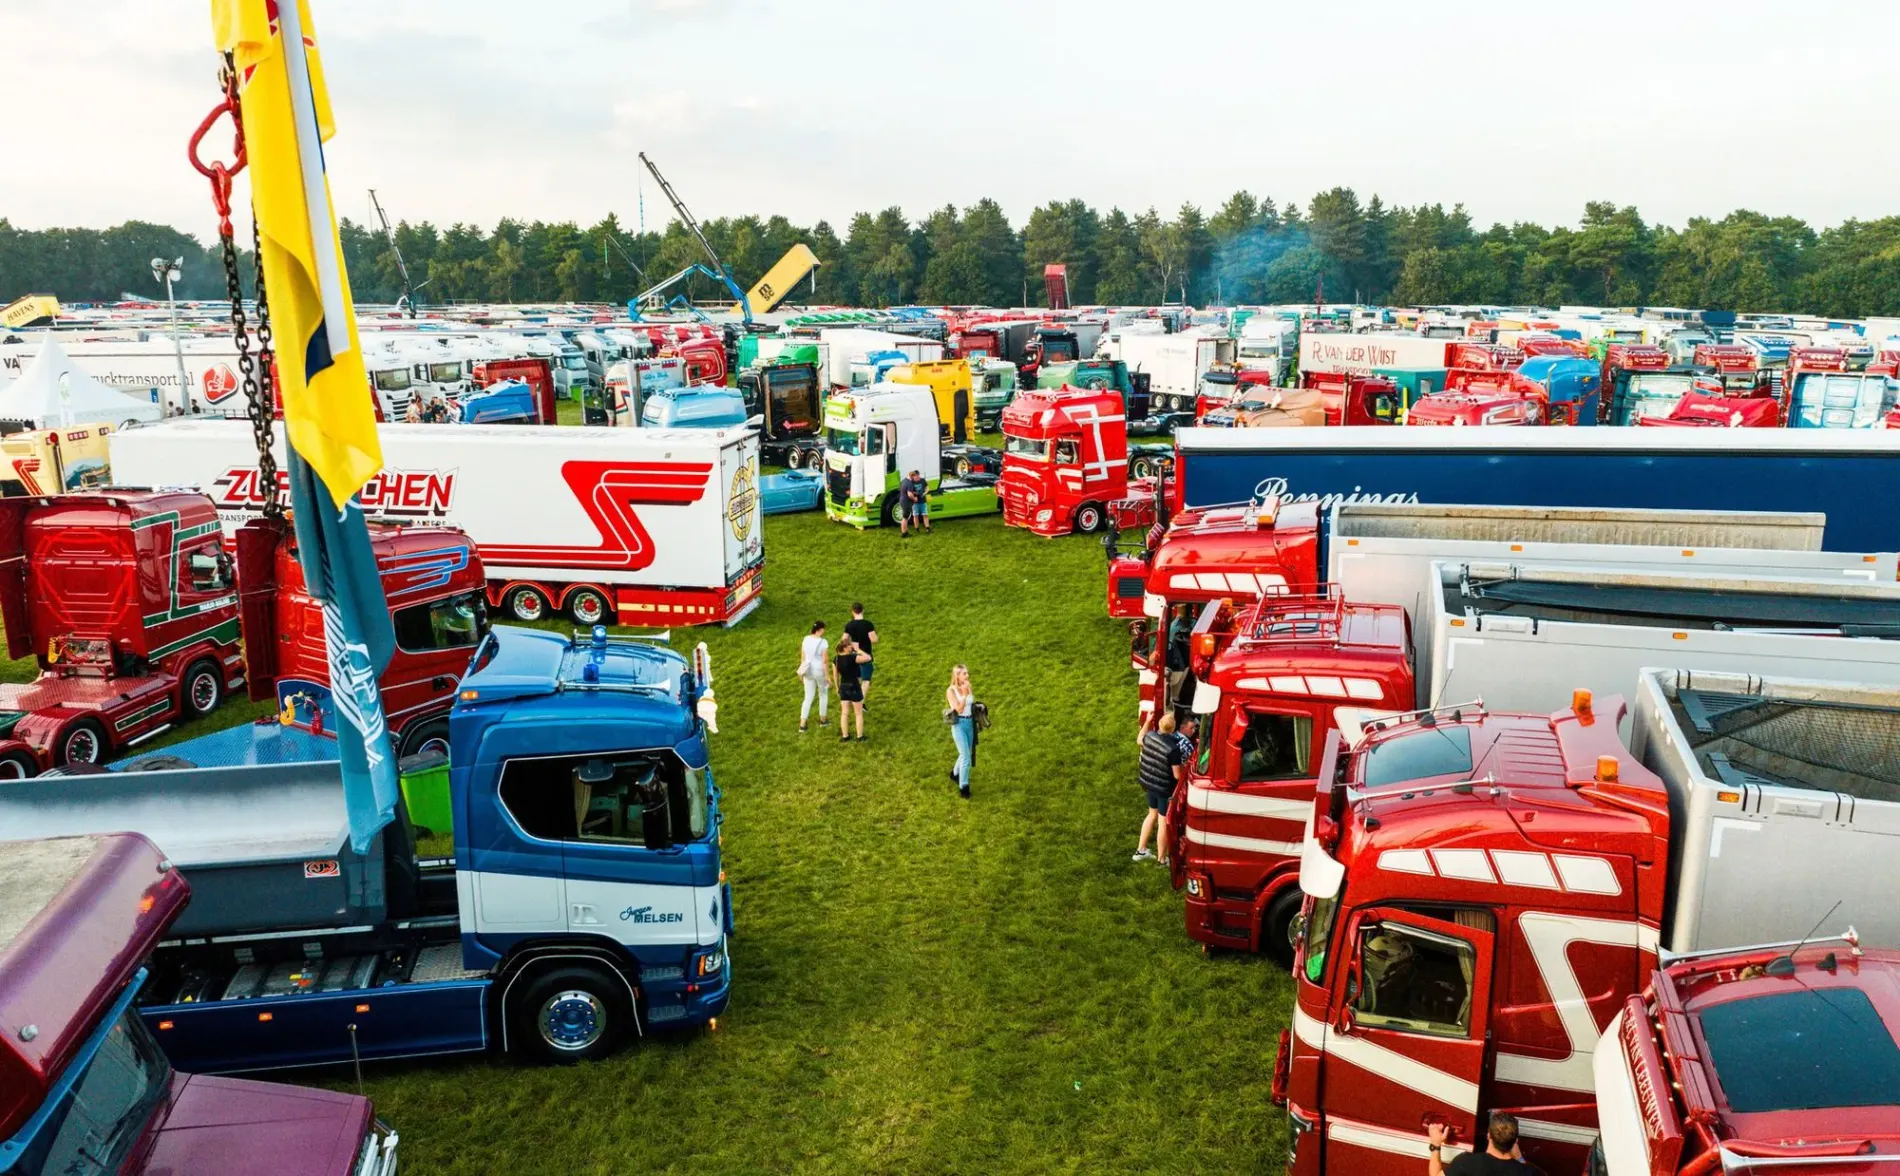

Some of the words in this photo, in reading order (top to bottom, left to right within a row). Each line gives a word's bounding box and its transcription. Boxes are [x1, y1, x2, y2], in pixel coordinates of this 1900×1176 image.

[7, 302, 35, 322] HAVENS
[1325, 344, 1343, 360] VAN
[1346, 347, 1364, 361] DER
[634, 912, 683, 924] MELSEN
